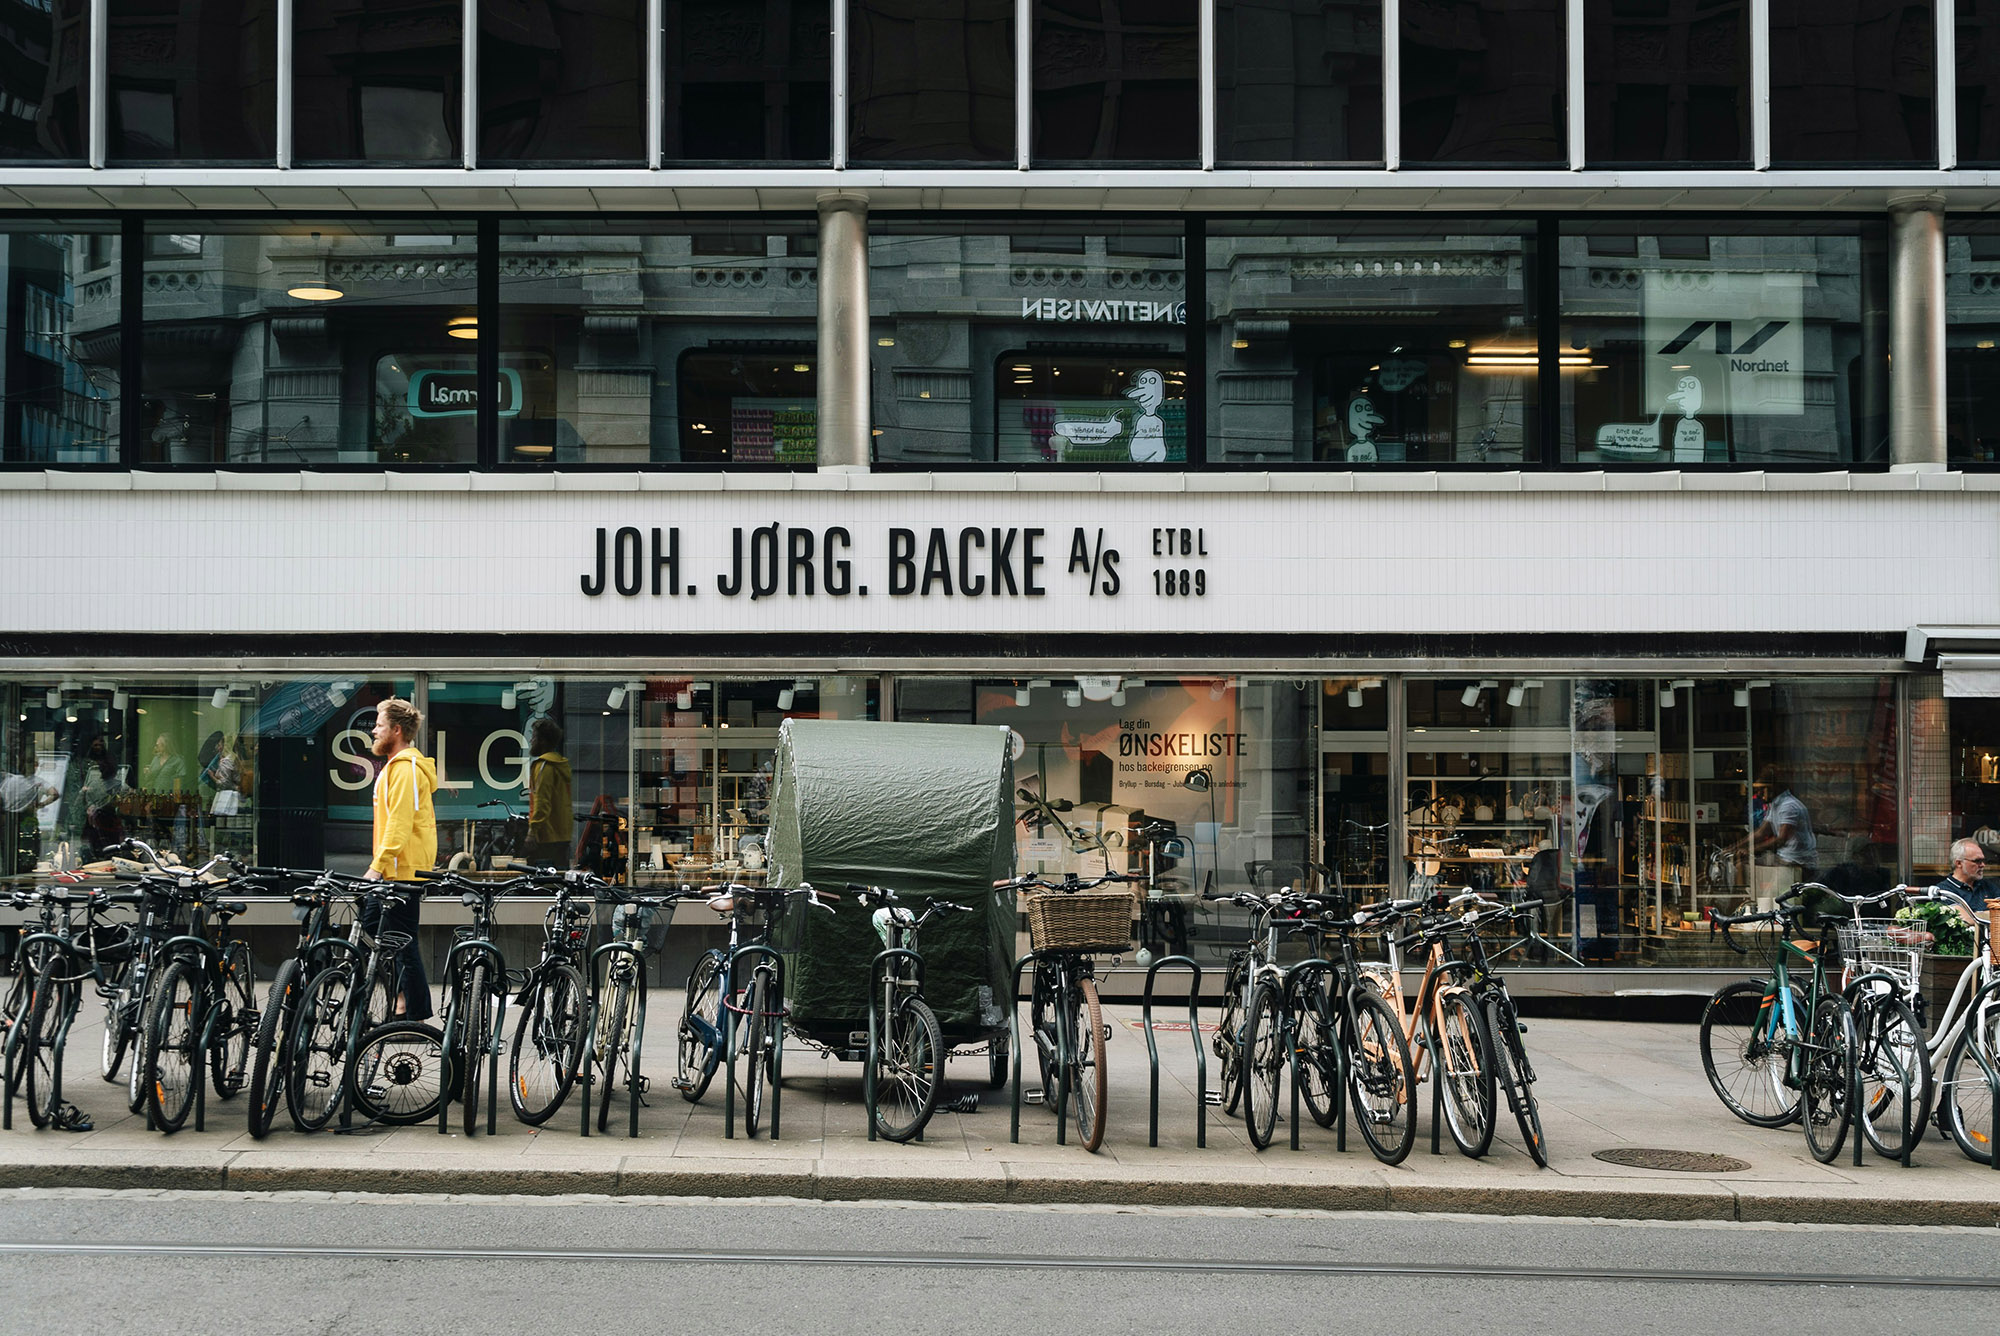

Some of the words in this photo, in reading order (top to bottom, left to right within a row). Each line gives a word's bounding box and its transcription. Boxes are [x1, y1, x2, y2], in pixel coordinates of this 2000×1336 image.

[1730, 358, 1789, 373] Nordnet
[1152, 528, 1208, 556] ETBL
[581, 527, 697, 597] JOH.
[718, 522, 868, 600] JØRG.
[889, 527, 1045, 597] BACKE
[1068, 527, 1121, 597] A/S
[1153, 569, 1206, 597] 1889
[1119, 719, 1135, 730] Lag
[1137, 719, 1150, 729] din
[1119, 733, 1248, 757] ØNSKELISTE
[330, 729, 530, 791] SLG
[1119, 762, 1135, 772] hos
[1119, 780, 1137, 789] Bryllup
[1144, 780, 1165, 789] Bursdag
